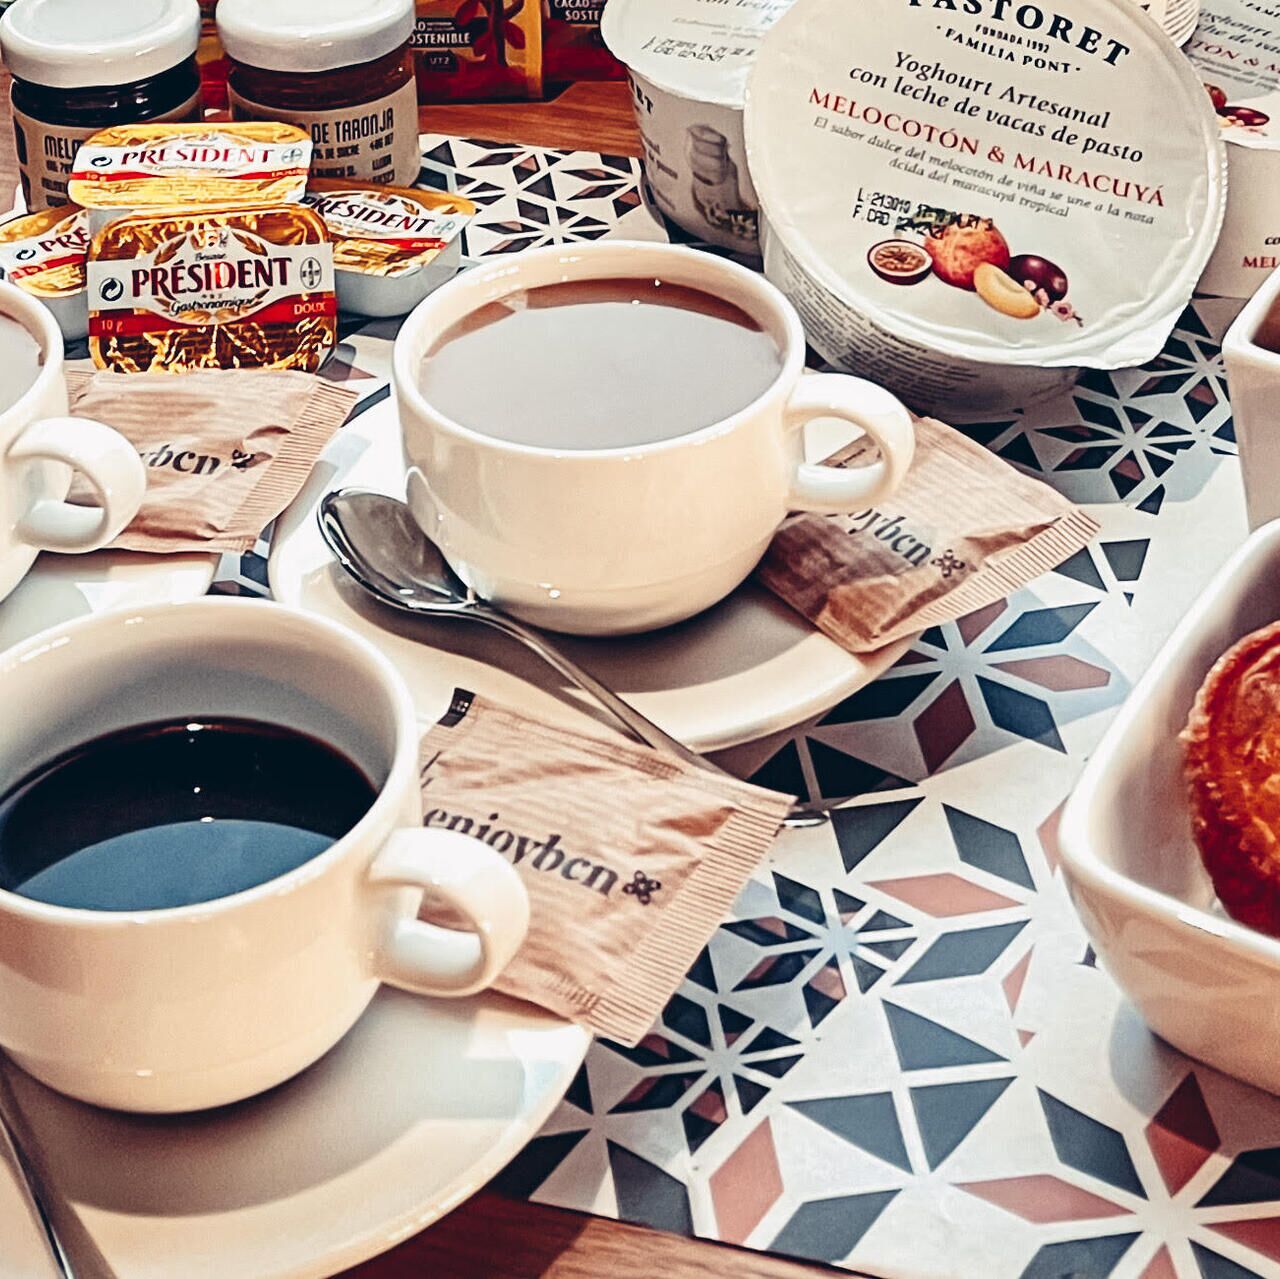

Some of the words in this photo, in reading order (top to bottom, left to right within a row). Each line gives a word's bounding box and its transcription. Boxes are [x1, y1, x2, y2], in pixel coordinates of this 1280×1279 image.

[409, 32, 470, 45] OSTENIBLE
[975, 24, 1023, 45] FUNDADA
[1199, 10, 1272, 38] oghourt
[945, 28, 1015, 62] FAMILIA
[1022, 55, 1071, 73] PONT
[895, 51, 993, 96] Yoghourt
[999, 85, 1111, 129] Artesanal
[312, 122, 330, 144] DE
[335, 107, 394, 143] TARONJA
[849, 67, 888, 89] con
[893, 76, 949, 108] leche
[953, 97, 981, 117] de
[986, 110, 1047, 137] vacas
[1051, 125, 1079, 146] de
[1082, 138, 1144, 163] pasto
[809, 88, 979, 156] MELOCOTÓN
[987, 145, 1006, 164] &
[1013, 152, 1165, 207] MARACUYÁ
[813, 116, 829, 129] El
[831, 123, 867, 142] sabor
[868, 135, 903, 154] dulce
[905, 147, 927, 162] del
[929, 155, 994, 182] melocotón
[997, 174, 1015, 188] de
[1067, 195, 1092, 209] une
[927, 169, 949, 184] del
[1019, 195, 1071, 219] tropical
[131, 257, 292, 300] PRÉSIDENT
[101, 321, 114, 331] 10
[422, 808, 620, 898] enjoybcn
